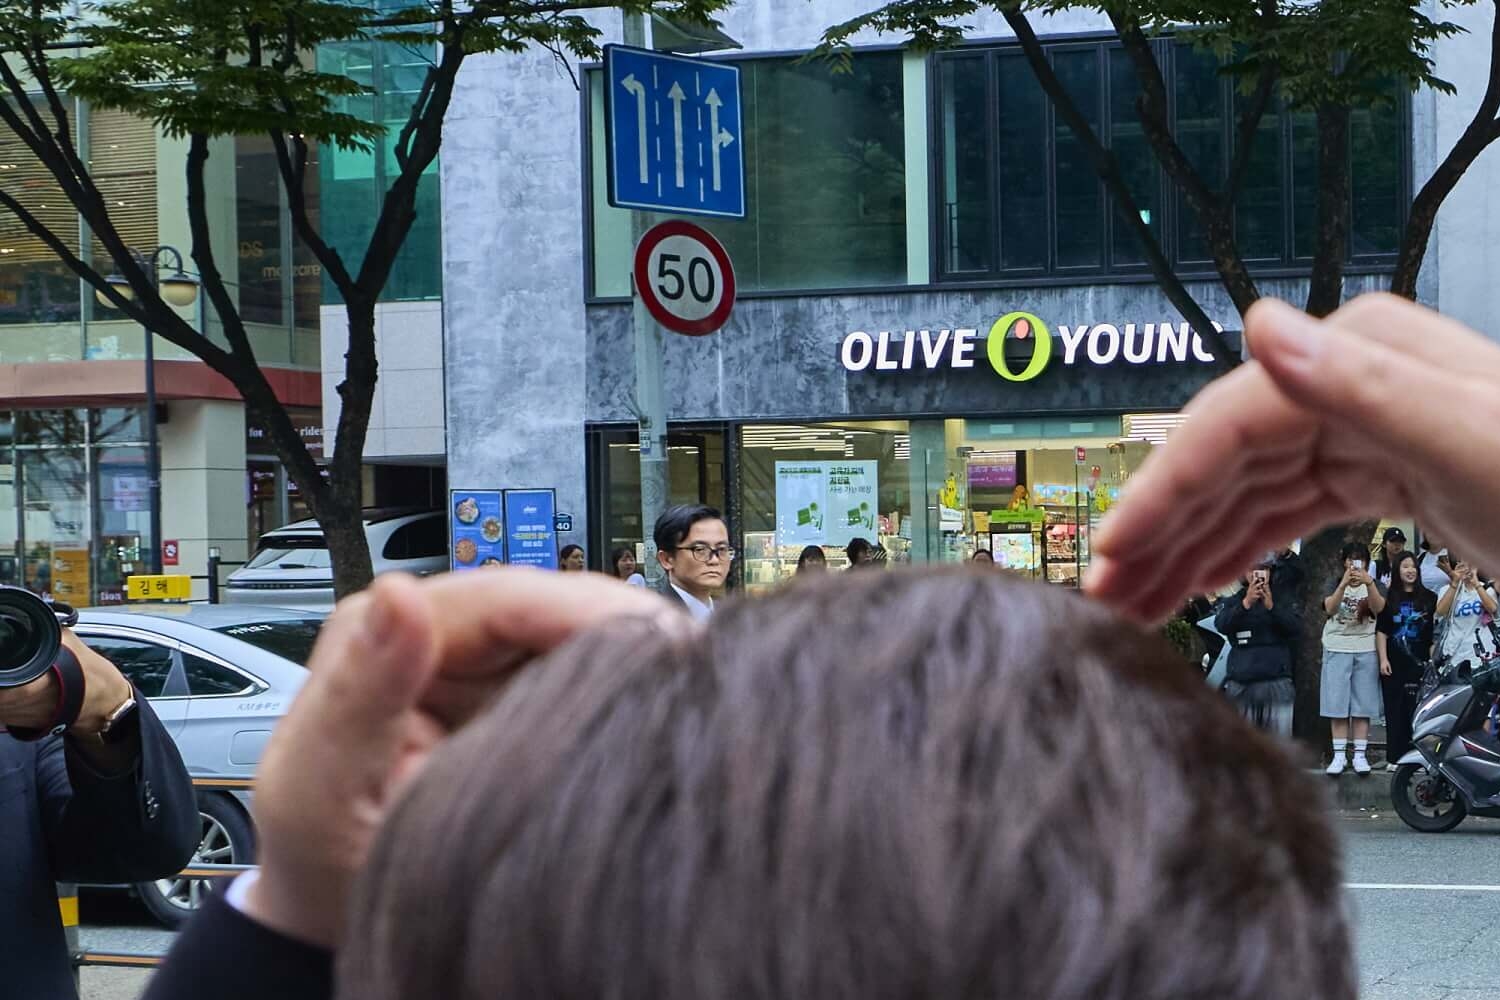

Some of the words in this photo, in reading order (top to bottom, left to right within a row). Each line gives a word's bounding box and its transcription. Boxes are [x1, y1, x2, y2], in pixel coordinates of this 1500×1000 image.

[658, 253, 715, 303] 50
[841, 328, 979, 371] OLIVE
[139, 580, 168, 595] 김해
